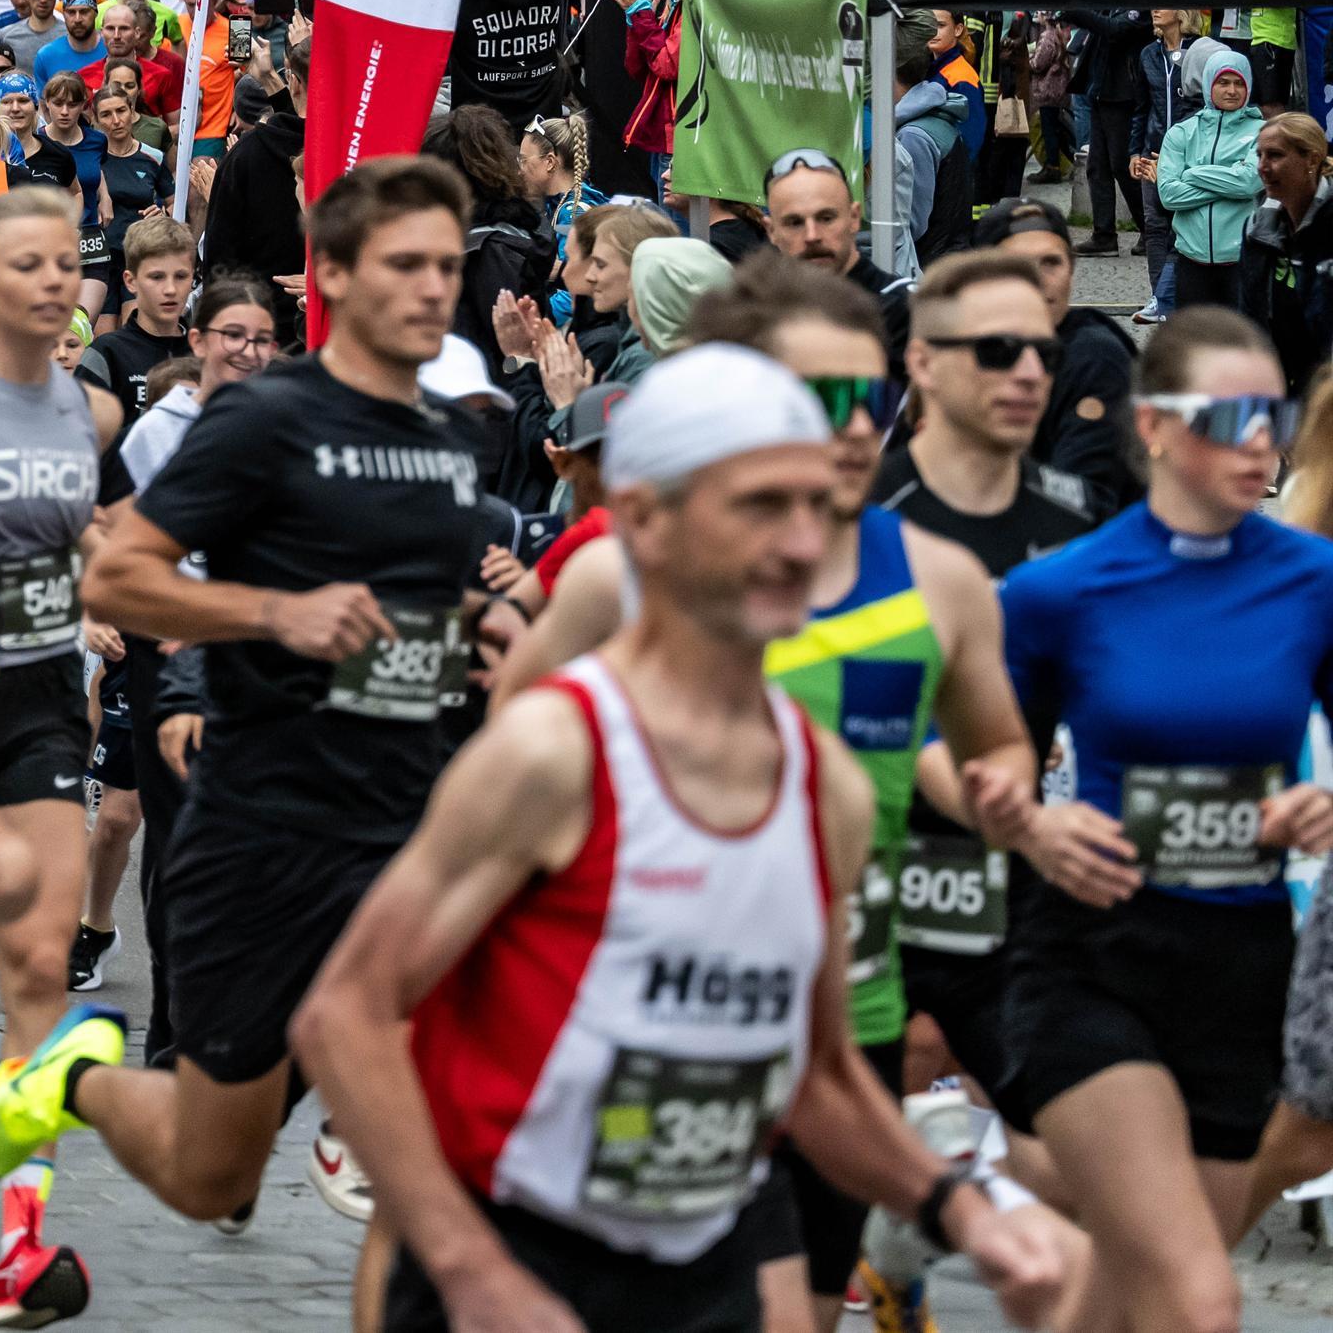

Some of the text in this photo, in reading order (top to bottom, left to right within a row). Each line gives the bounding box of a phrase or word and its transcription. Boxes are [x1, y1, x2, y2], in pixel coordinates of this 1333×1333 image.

[472, 6, 560, 37] SQUADRA
[478, 71, 528, 82] LAUFSPORT
[79, 237, 103, 253] 835
[899, 866, 986, 916] 905
